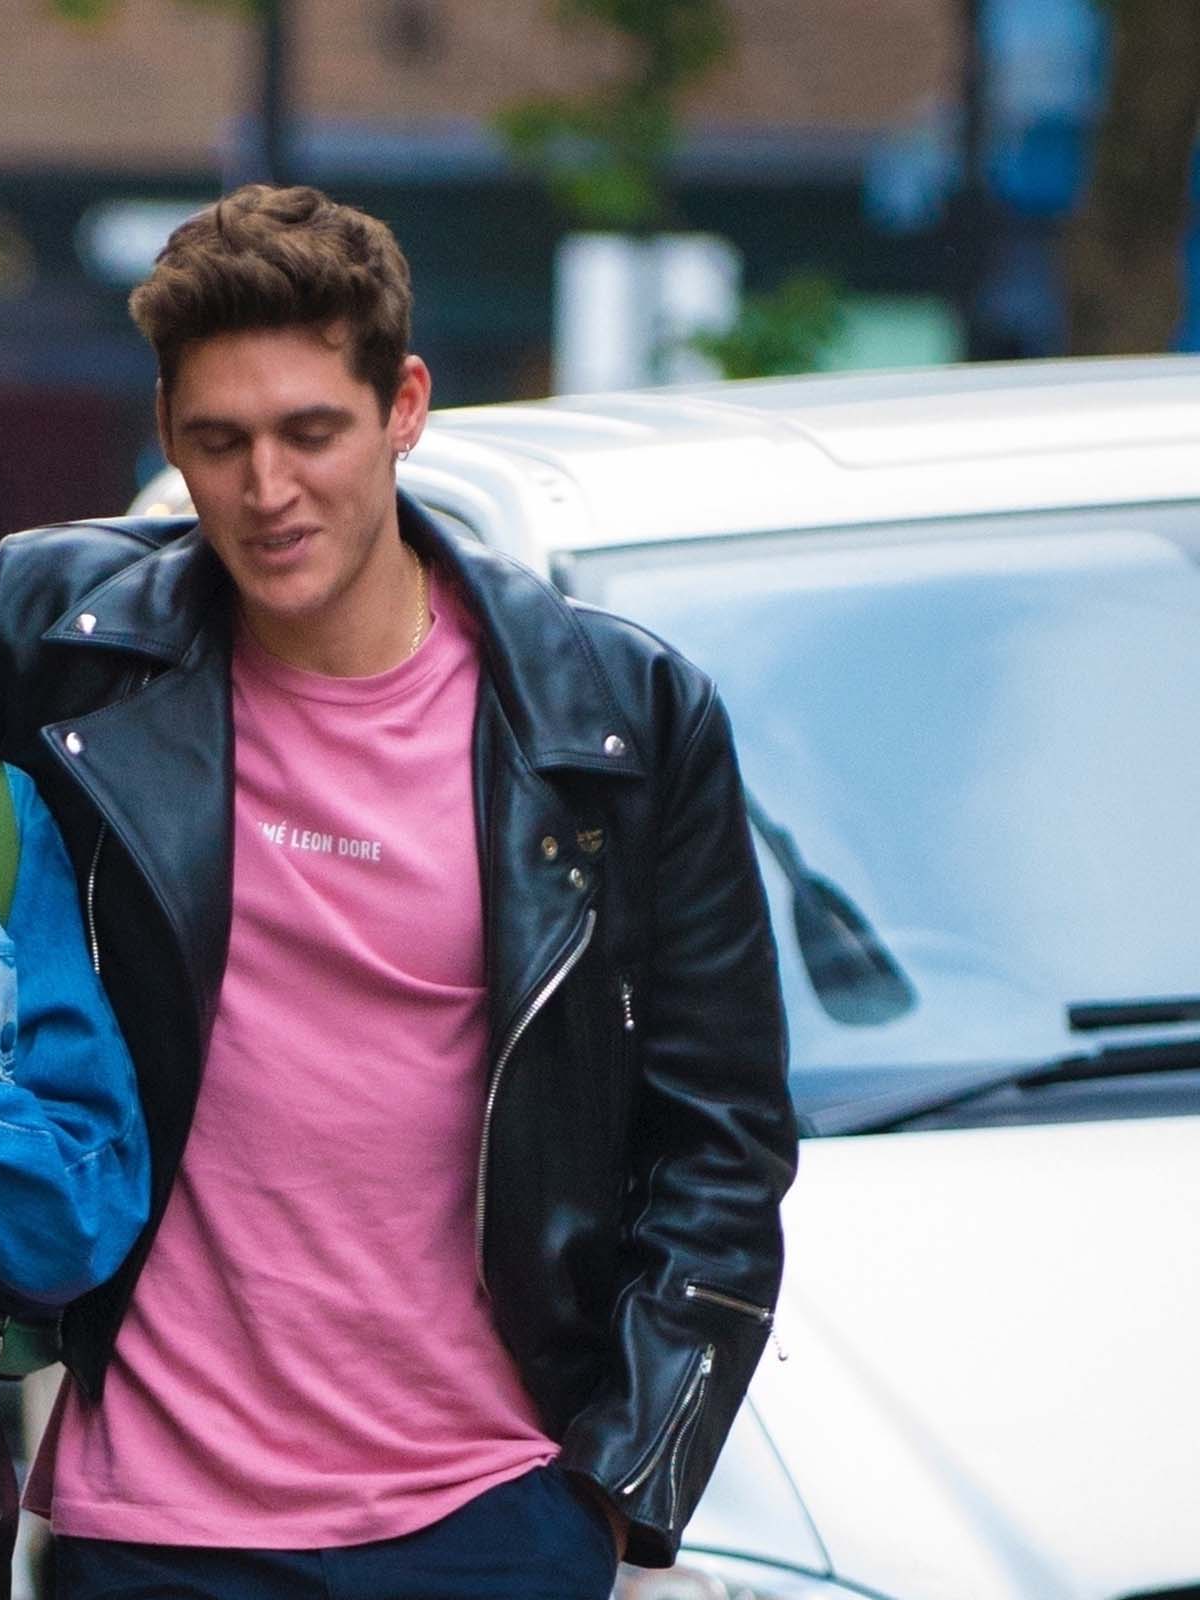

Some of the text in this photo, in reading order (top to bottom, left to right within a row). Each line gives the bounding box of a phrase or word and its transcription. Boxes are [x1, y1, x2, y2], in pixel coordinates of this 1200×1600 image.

[258, 820, 382, 862] MÉ LEON DORE
